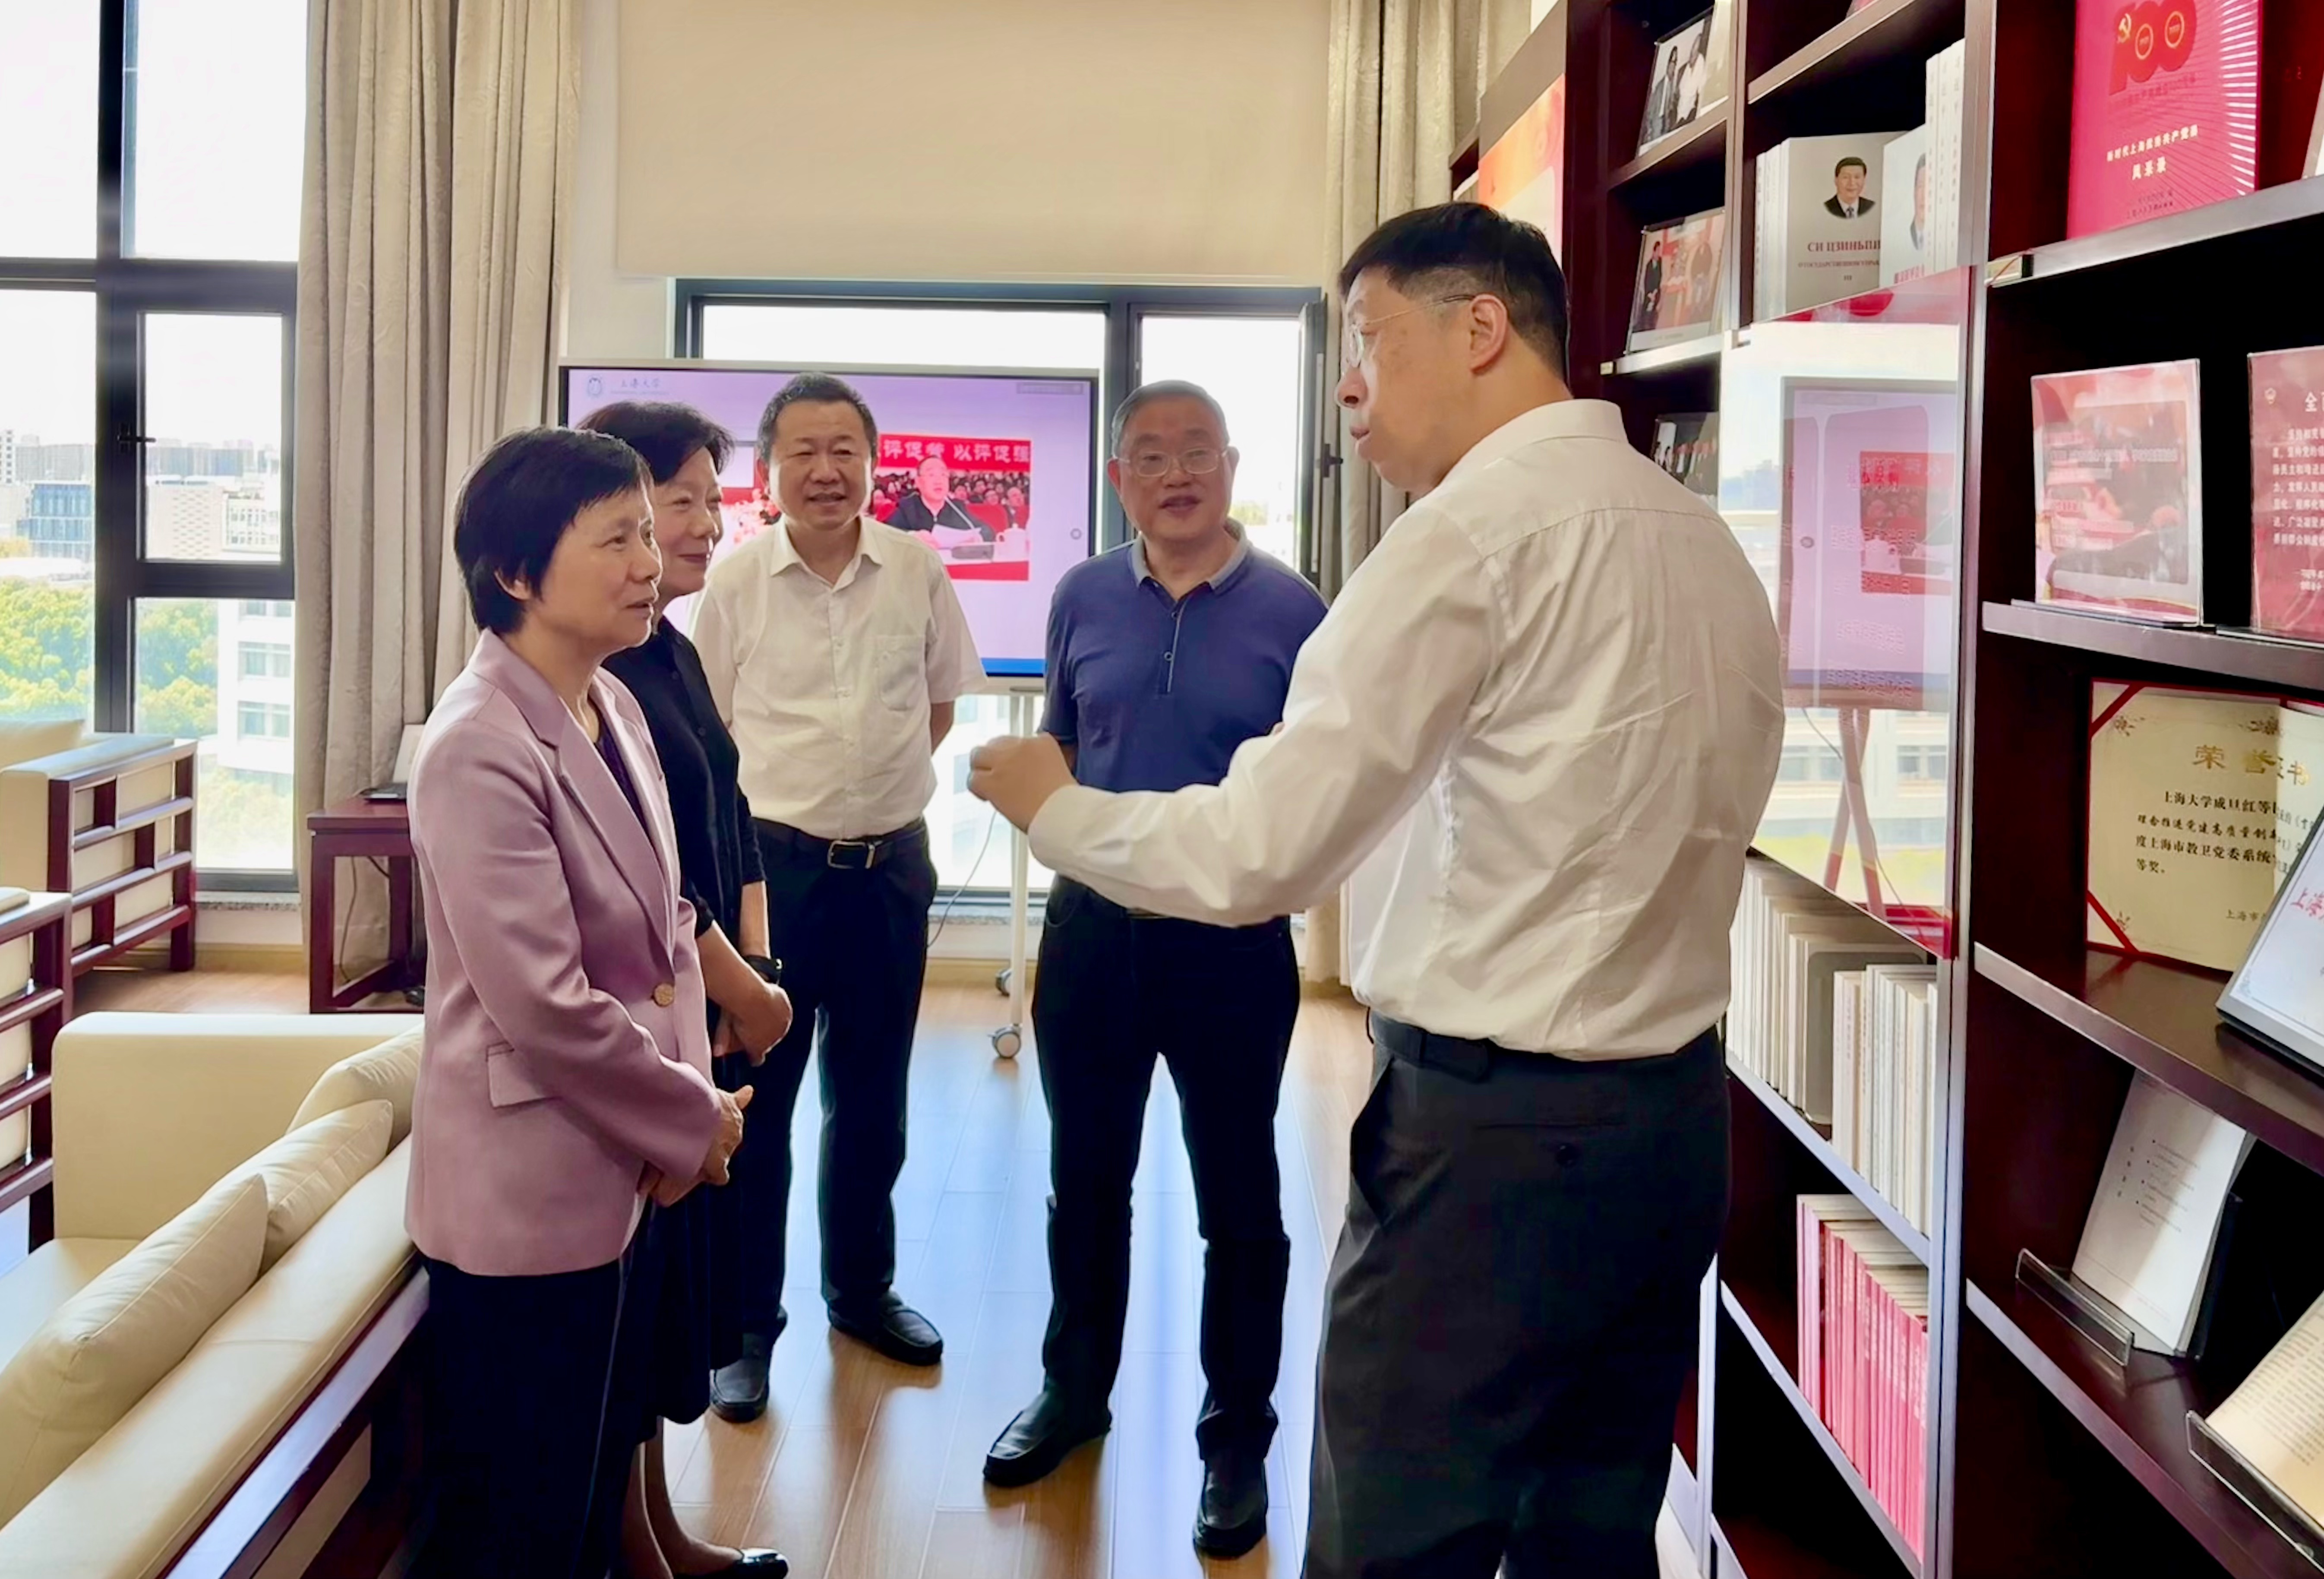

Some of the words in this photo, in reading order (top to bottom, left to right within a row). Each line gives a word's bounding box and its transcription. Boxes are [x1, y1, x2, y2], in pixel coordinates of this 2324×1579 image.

[1807, 242, 1823, 252] СИ
[2305, 392, 2324, 412] 全
[2226, 908, 2266, 922] 上海市
